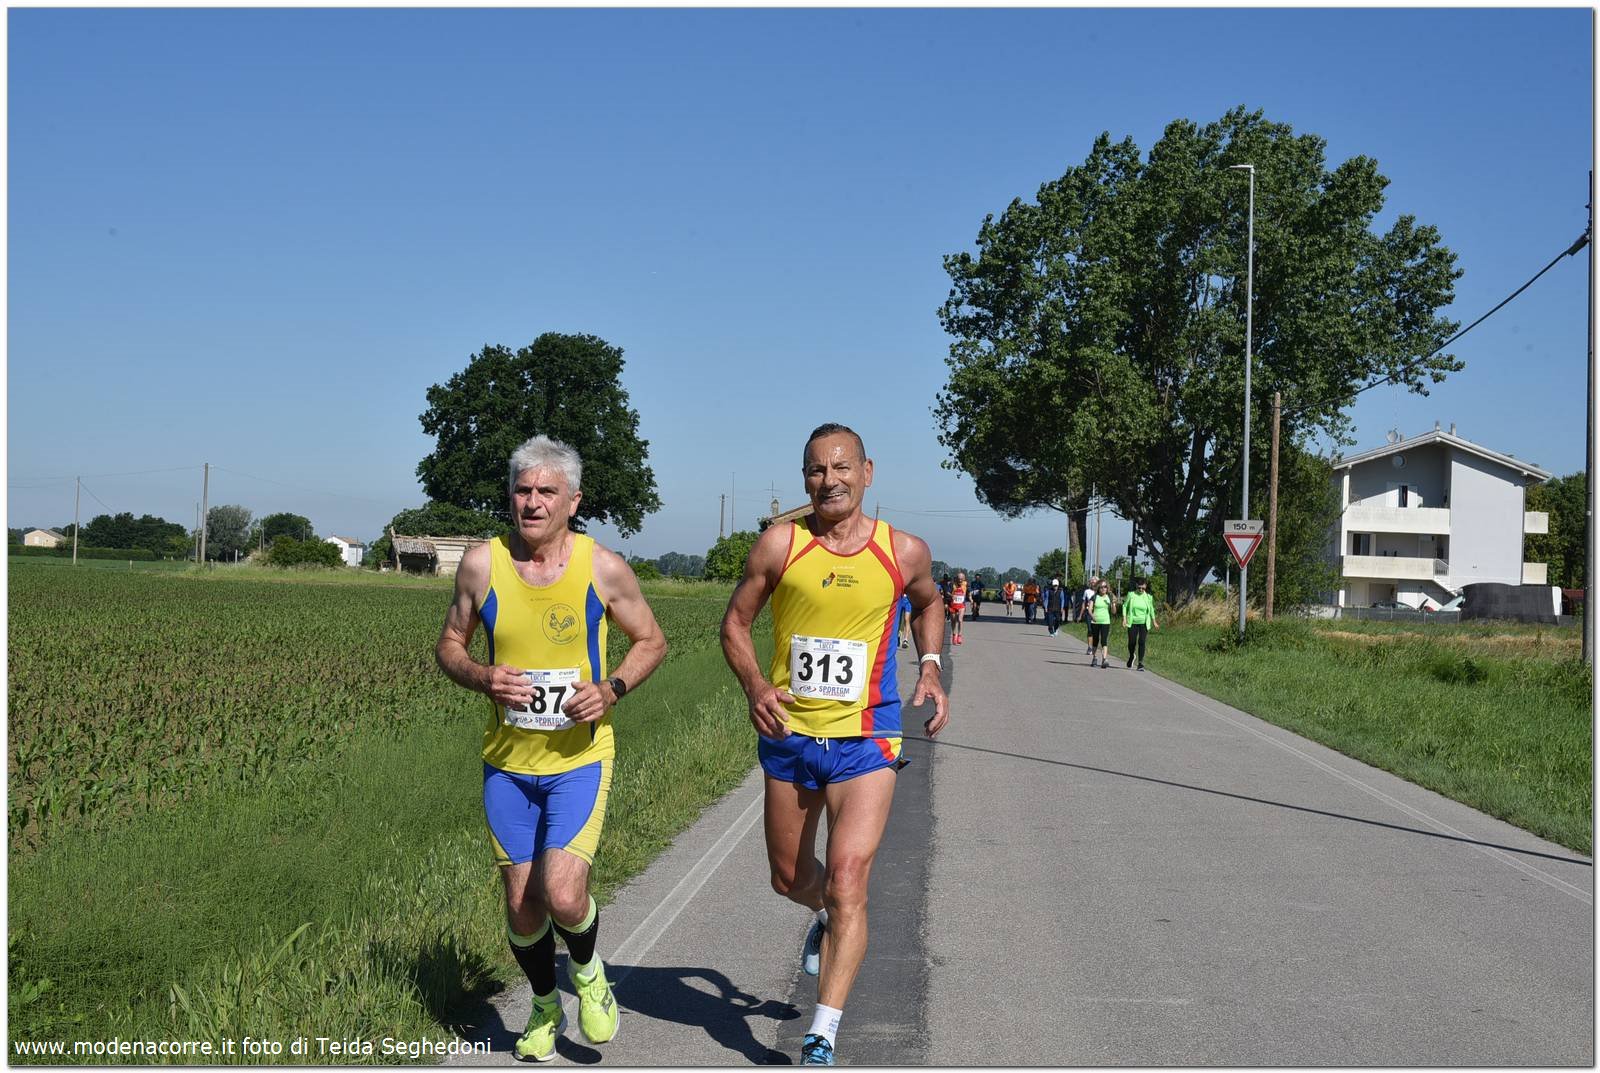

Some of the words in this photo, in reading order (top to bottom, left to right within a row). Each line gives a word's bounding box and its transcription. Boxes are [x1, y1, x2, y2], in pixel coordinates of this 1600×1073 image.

[1233, 523, 1247, 531] 150
[797, 652, 853, 685] 313
[511, 686, 567, 714] 87
